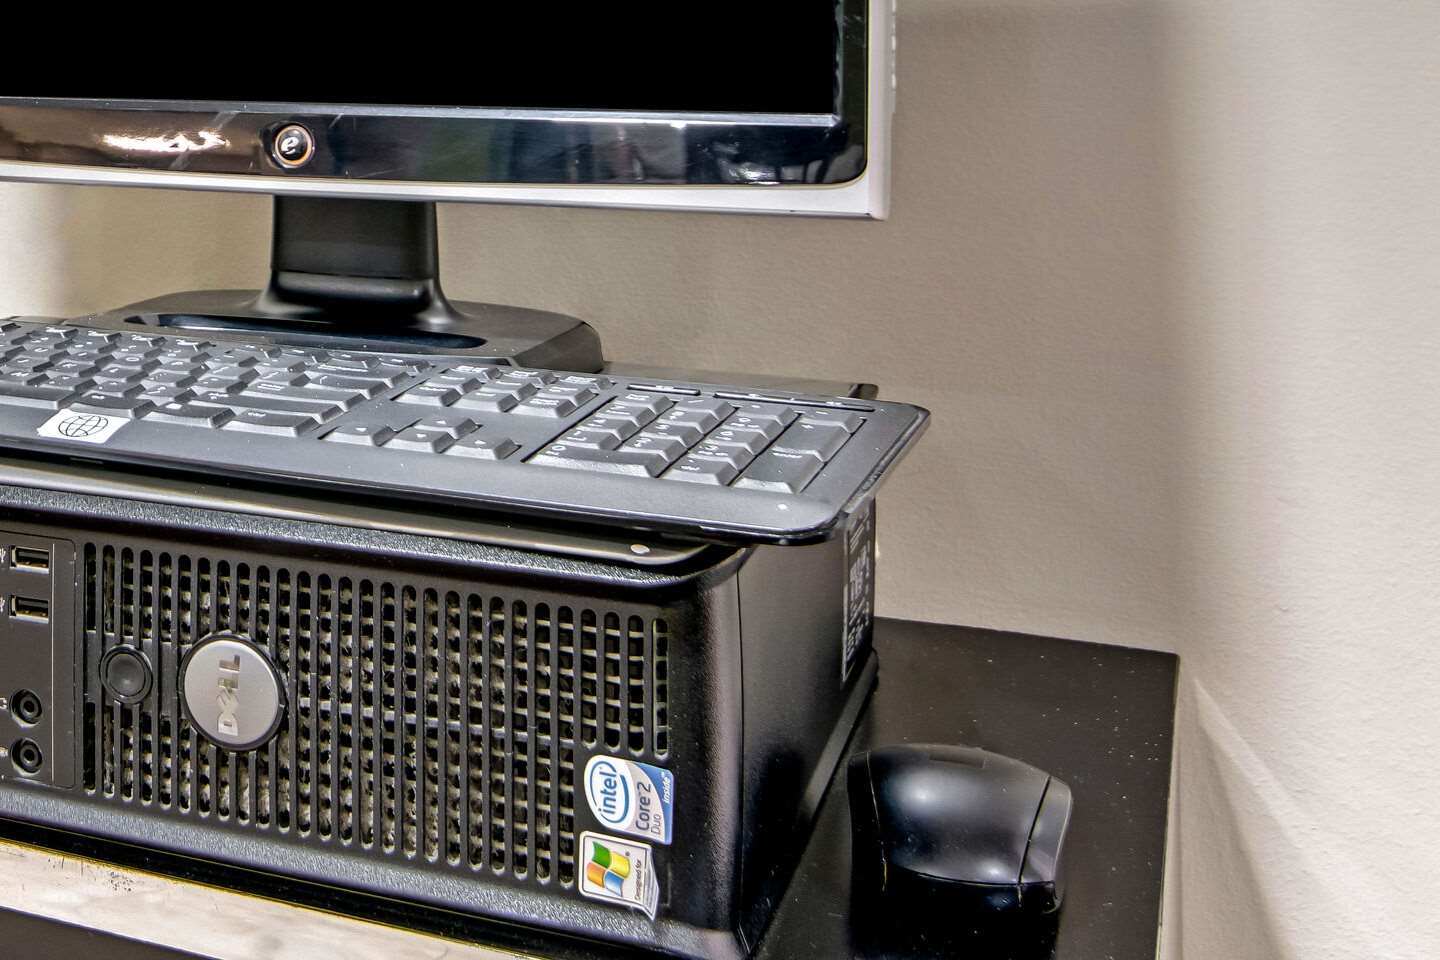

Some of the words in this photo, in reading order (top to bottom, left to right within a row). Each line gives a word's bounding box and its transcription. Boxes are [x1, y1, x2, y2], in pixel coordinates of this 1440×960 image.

[598, 771, 617, 814] intel
[637, 781, 651, 793] 2
[636, 796, 651, 831] Core
[651, 813, 661, 835] Duo
